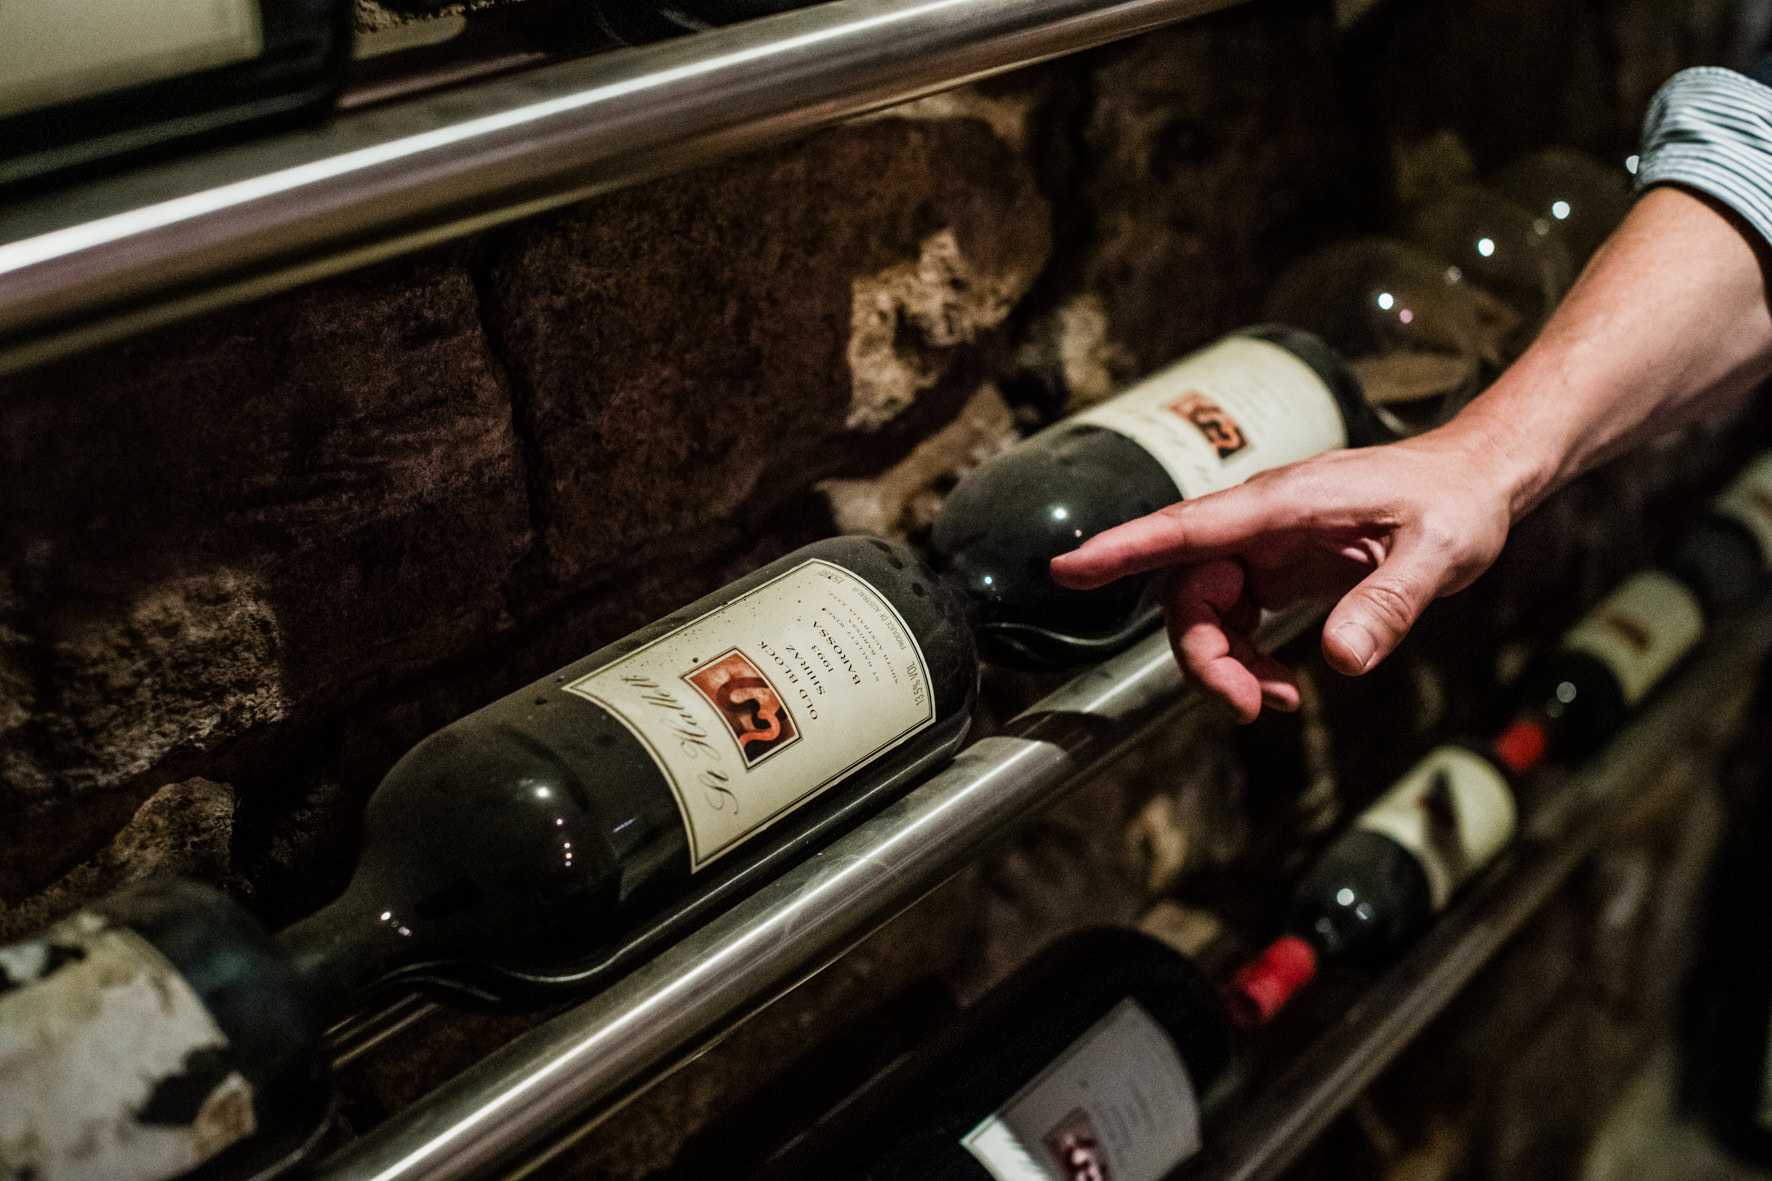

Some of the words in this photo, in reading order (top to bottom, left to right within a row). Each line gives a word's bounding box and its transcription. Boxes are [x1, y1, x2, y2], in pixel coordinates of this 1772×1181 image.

[852, 586, 880, 613] AUSTRALIA
[879, 612, 889, 623] OF
[848, 617, 876, 656] BAROSSA
[849, 608, 884, 651] AUSTRALIA
[887, 620, 906, 650] PRODUCE
[760, 641, 799, 684] BLOCK
[785, 644, 826, 695] SHIRAZ
[811, 645, 834, 672] 1993
[813, 620, 861, 685] BAROSSA
[906, 661, 918, 681] VOL
[621, 675, 722, 760] Hallett
[799, 688, 818, 720] OLD
[698, 769, 739, 815] St
